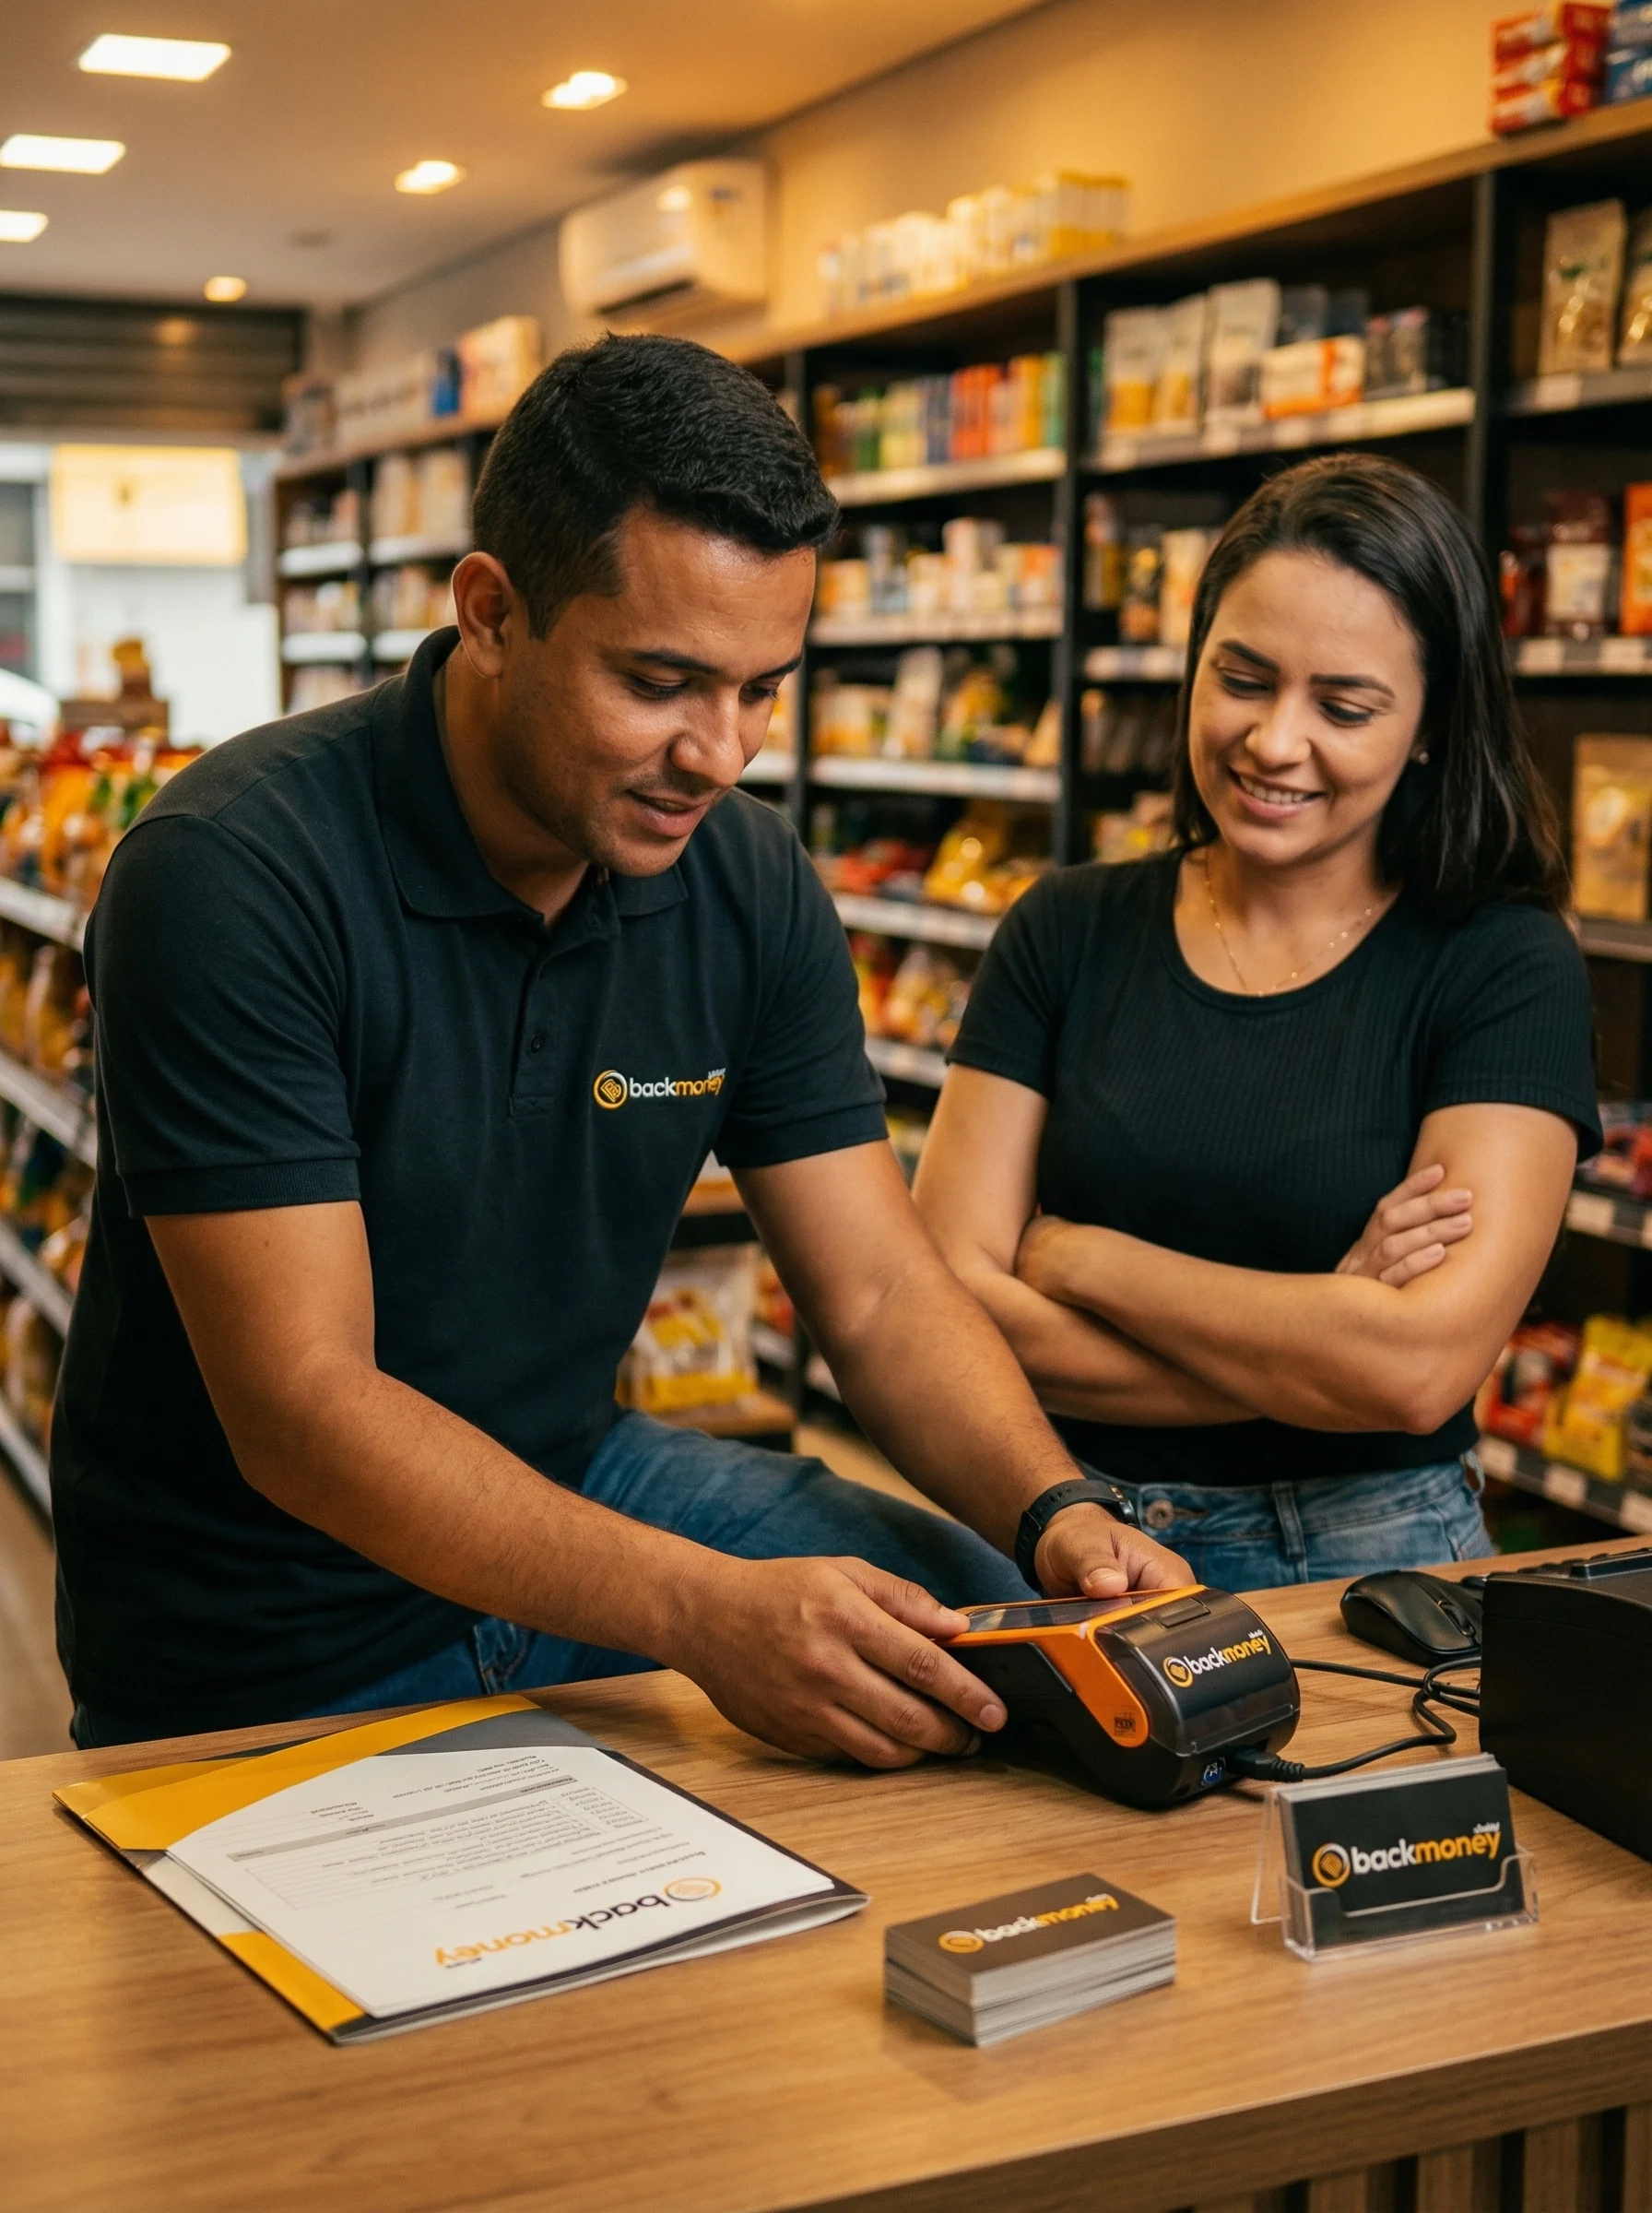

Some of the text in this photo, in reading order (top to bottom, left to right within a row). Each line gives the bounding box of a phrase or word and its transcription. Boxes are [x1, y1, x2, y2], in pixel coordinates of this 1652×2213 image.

[630, 1075, 726, 1097] backmoney
[1184, 1636, 1271, 1675] backmoney
[1351, 1831, 1502, 1876] backmoney
[434, 1892, 671, 1968] backmoney
